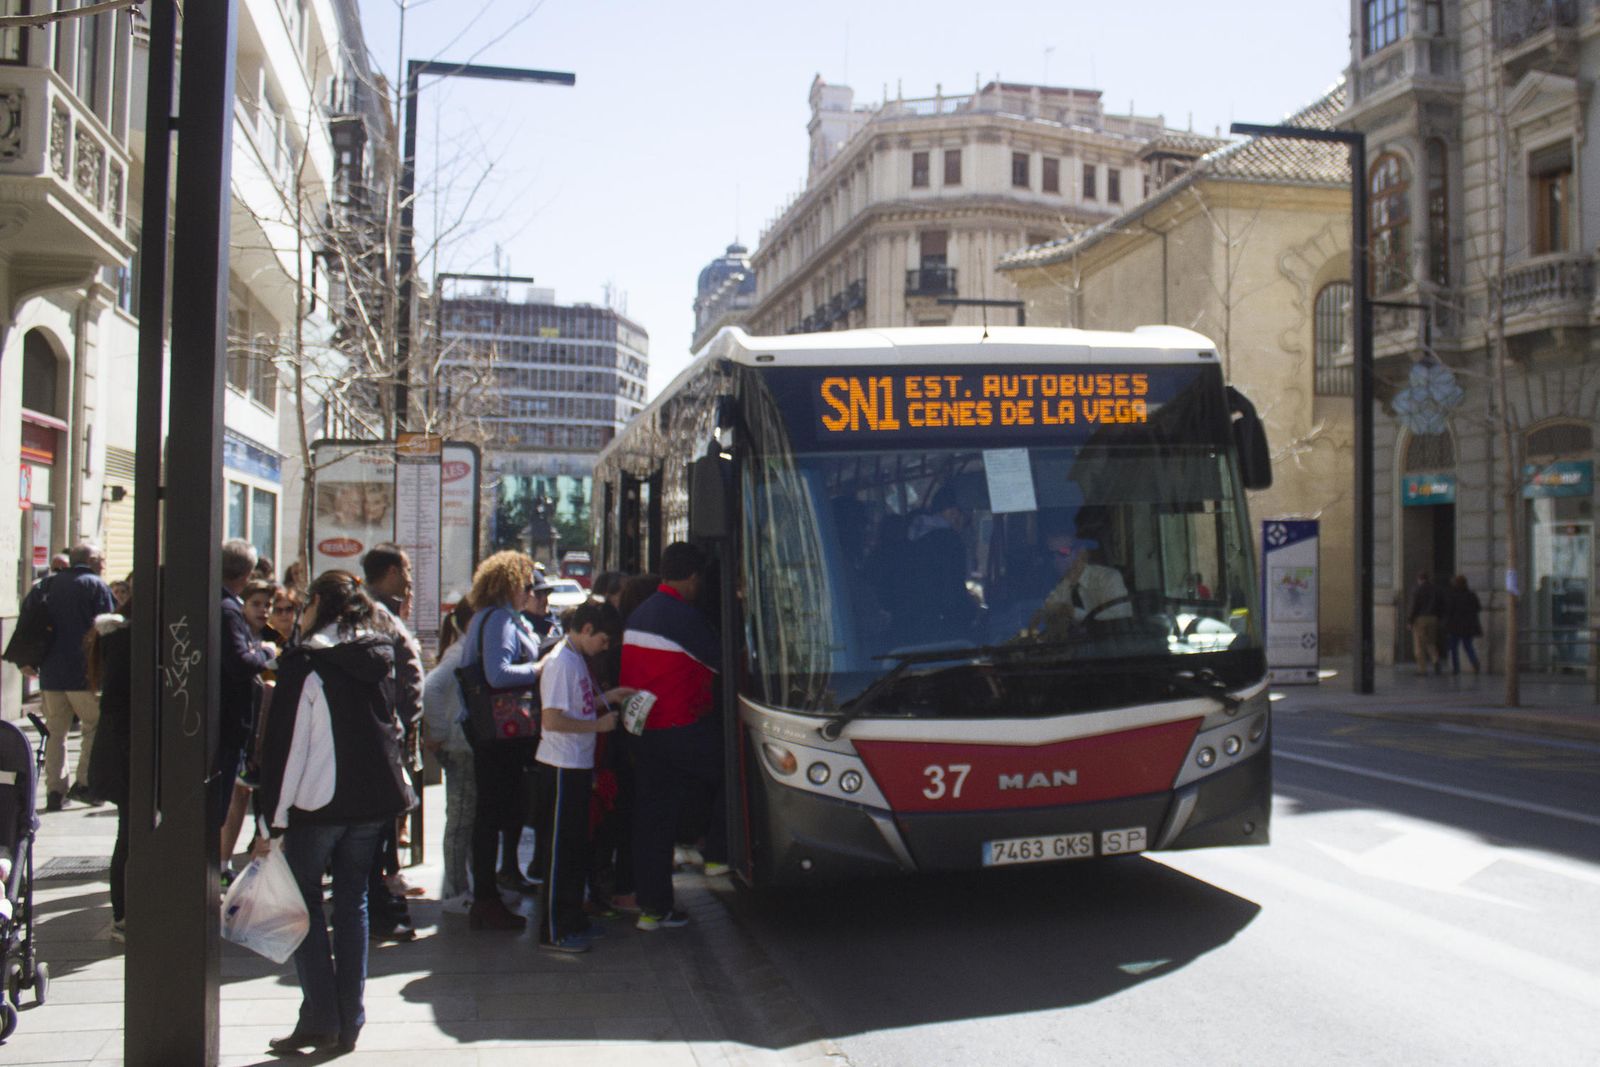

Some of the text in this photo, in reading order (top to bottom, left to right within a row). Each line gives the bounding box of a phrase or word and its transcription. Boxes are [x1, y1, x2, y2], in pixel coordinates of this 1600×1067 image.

[904, 374, 1148, 398] EST. AUTOBUSES
[820, 376, 900, 432] SN1
[907, 398, 1148, 427] CENES DE LA VEGA
[922, 764, 971, 800] 37
[998, 771, 1078, 790] MAN
[993, 835, 1091, 863] 7463 GKS
[1106, 830, 1143, 853] SP
